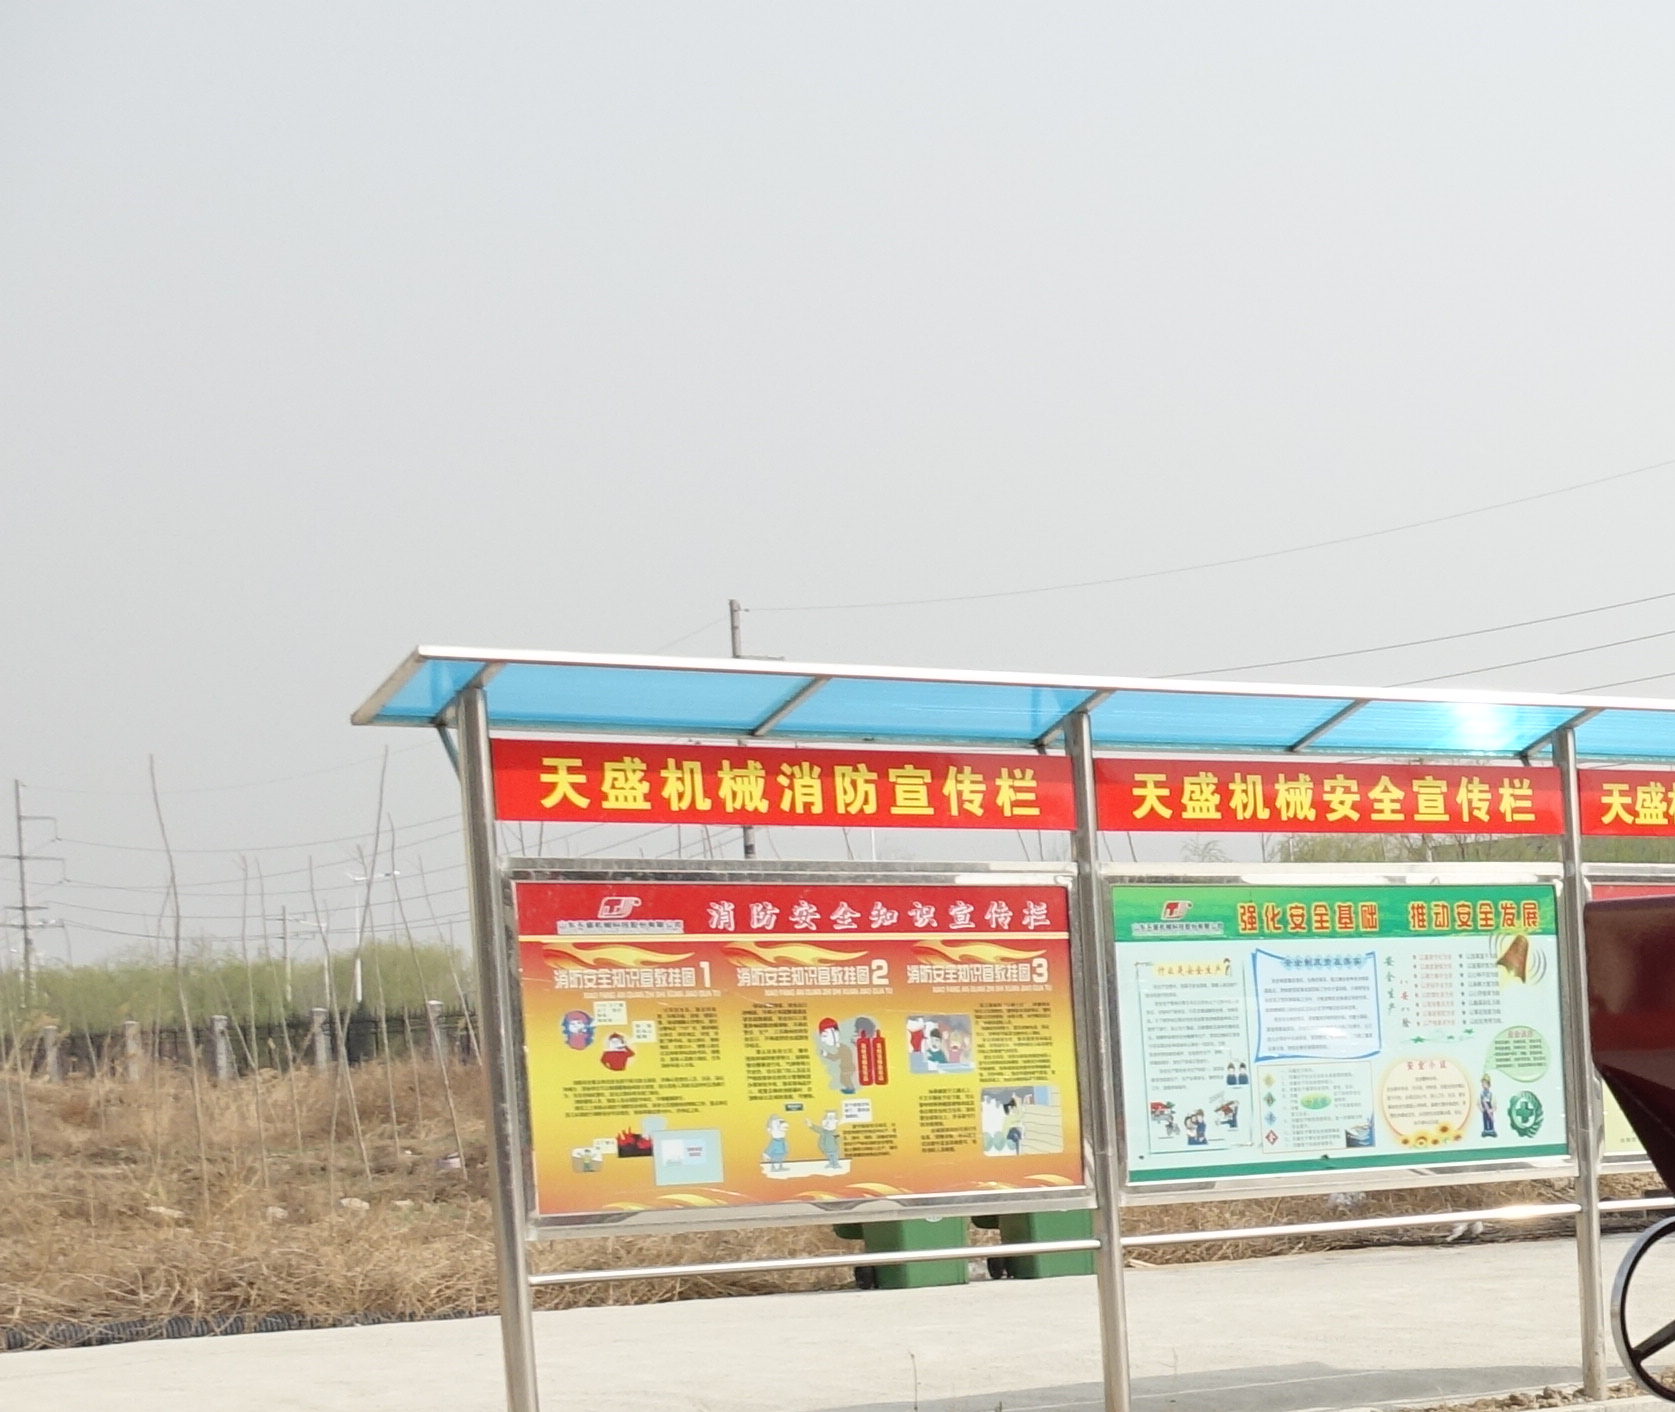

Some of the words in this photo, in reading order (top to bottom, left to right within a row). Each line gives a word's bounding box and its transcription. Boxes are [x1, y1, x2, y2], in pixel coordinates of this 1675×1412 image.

[539, 755, 1041, 819] 天盛机械消防宣传栏
[1131, 772, 1537, 824] 天盛机械安全宣传栏
[707, 900, 1050, 931] 消防安全知识宣传栏
[1238, 902, 1379, 933] 强化安全基础
[1408, 901, 1539, 931] 推动安全发展
